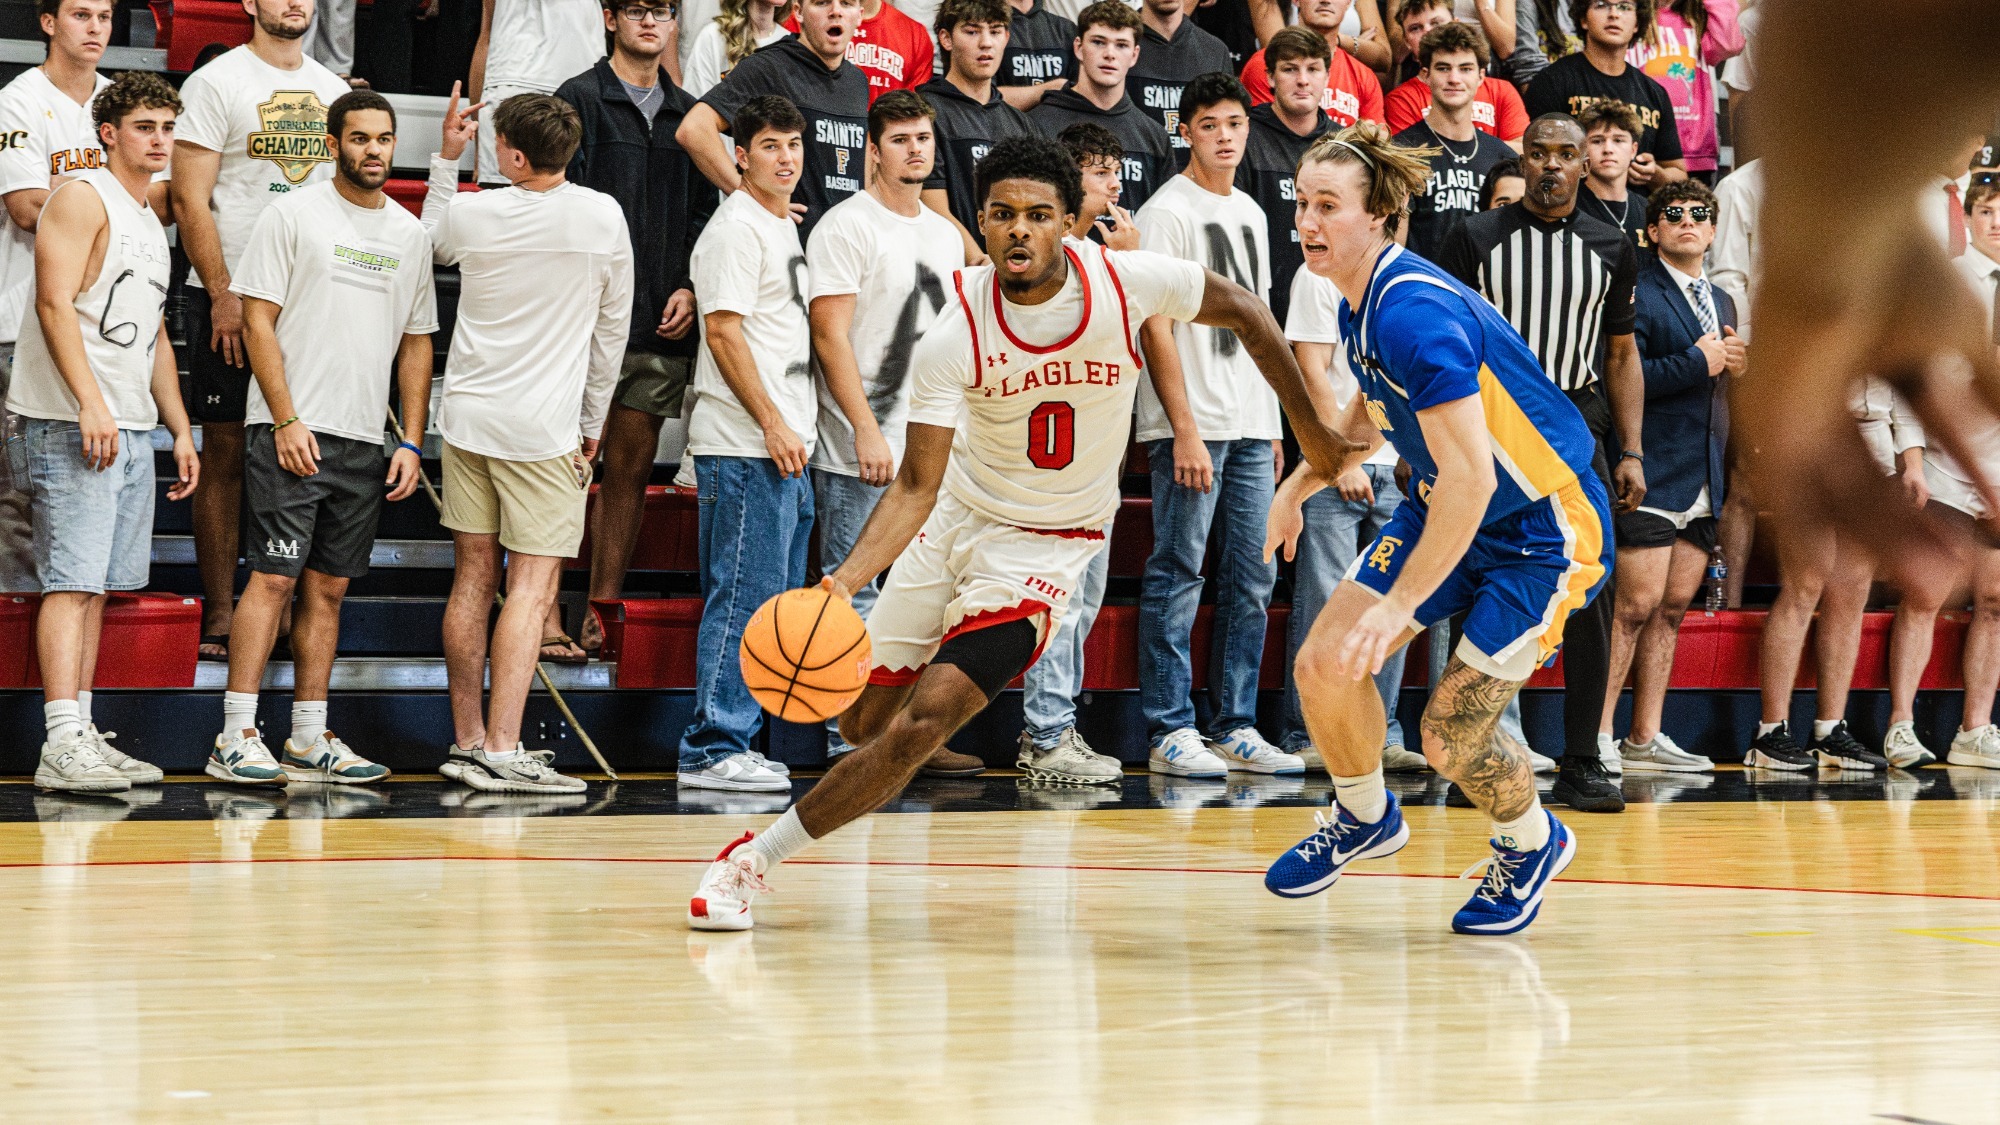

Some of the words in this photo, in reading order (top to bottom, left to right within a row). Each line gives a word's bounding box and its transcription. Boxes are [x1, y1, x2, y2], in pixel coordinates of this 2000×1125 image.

[845, 42, 904, 81] AGLER
[1144, 86, 1185, 109] SAIN
[266, 121, 328, 132] TOURNAMEN
[815, 119, 865, 149] SAINTS
[0, 130, 28, 152] BC
[252, 137, 331, 156] CHAMPION
[51, 148, 106, 175] FLAGL
[836, 148, 850, 175] F
[1427, 169, 1486, 197] FLAGL
[1434, 189, 1480, 213] SAINT
[1027, 401, 1075, 471] 0
[1025, 576, 1067, 601] PBC
[1164, 744, 1183, 761] N
[1234, 741, 1257, 759] N
